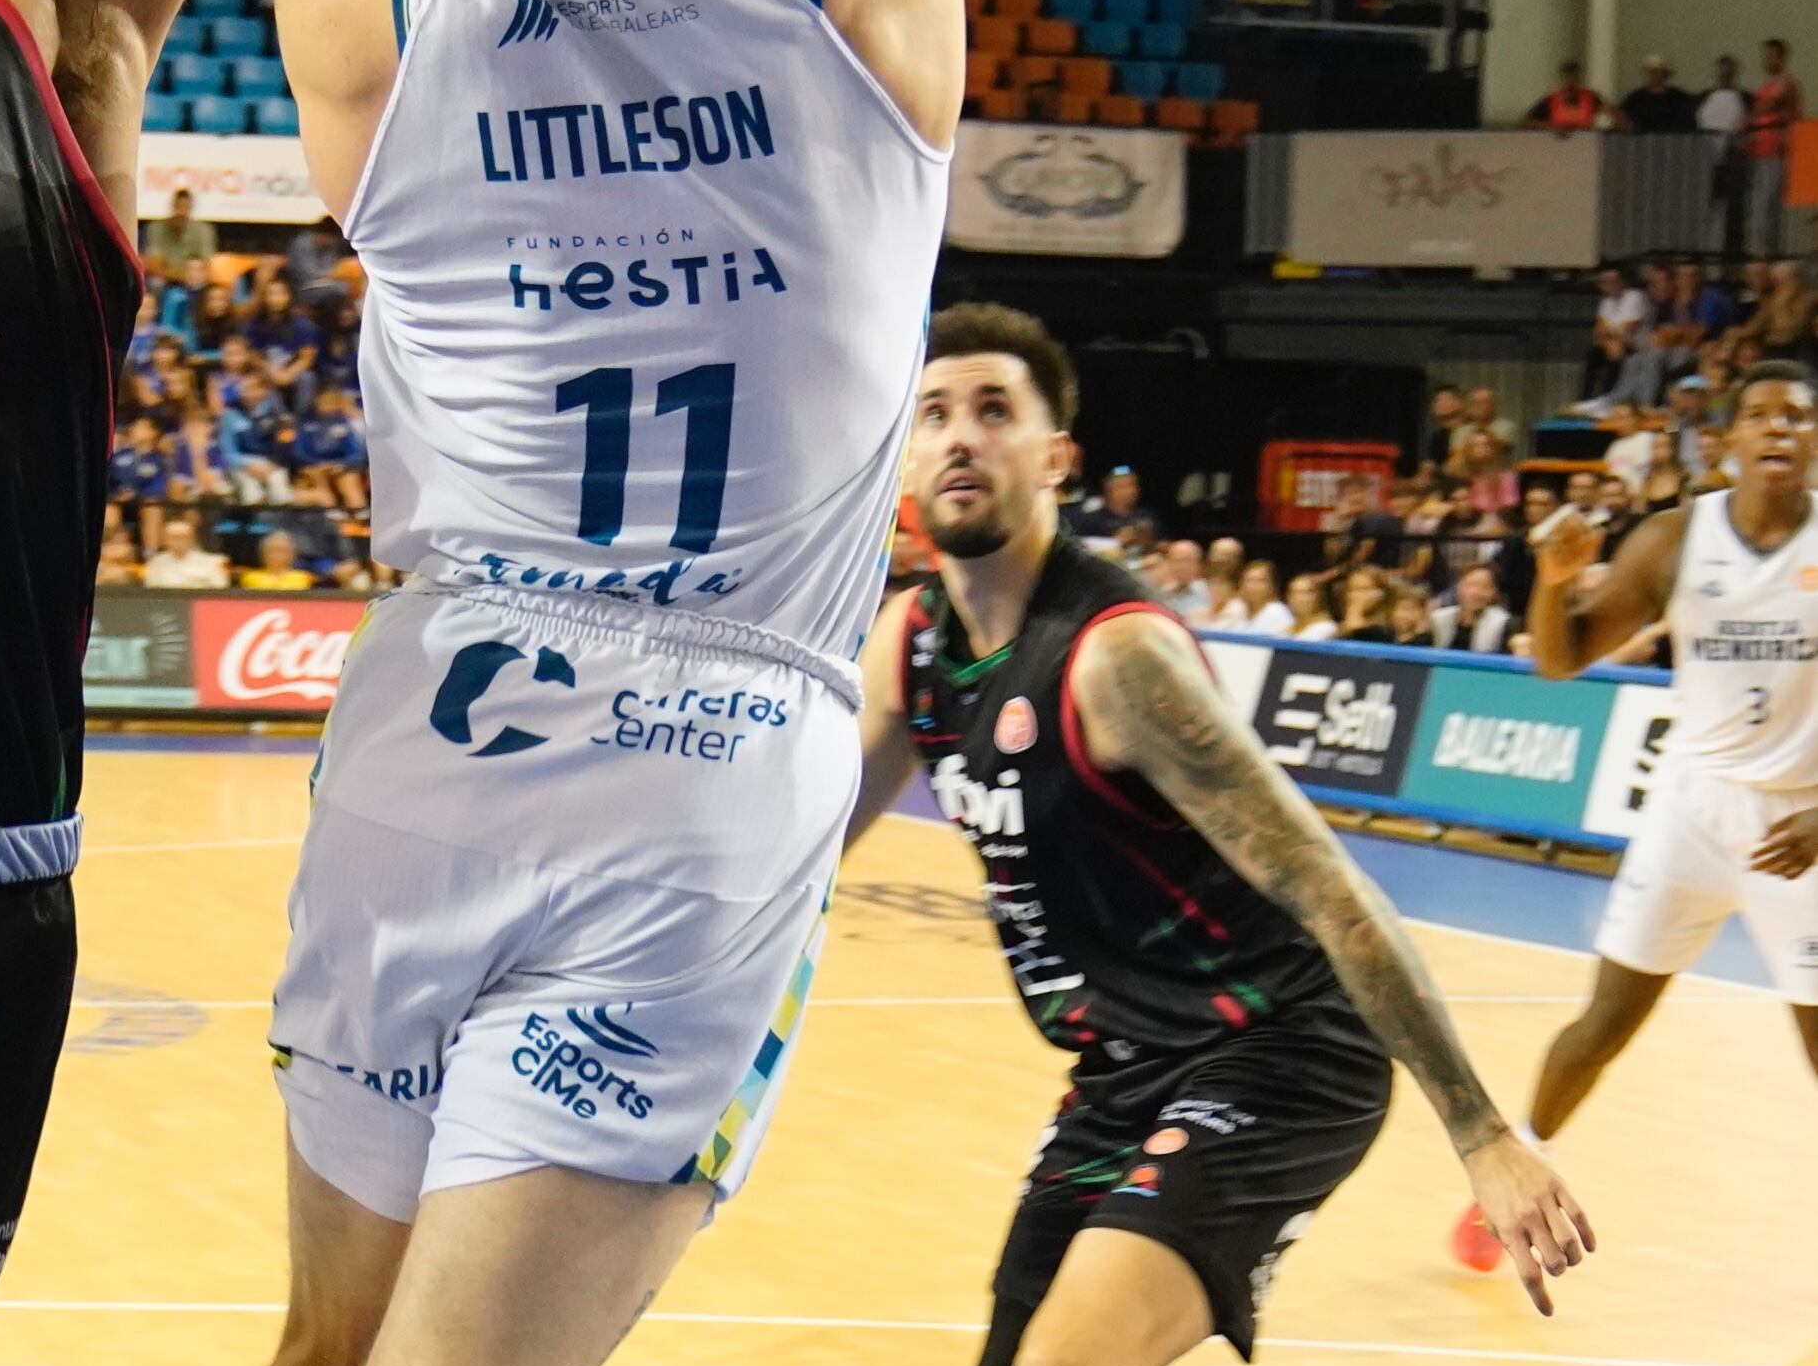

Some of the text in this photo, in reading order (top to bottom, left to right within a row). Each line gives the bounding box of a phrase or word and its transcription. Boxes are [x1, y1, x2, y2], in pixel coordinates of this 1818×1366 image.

[477, 85, 776, 183] LITTLESON
[506, 228, 695, 250] FUNDACIÓN
[554, 361, 736, 556] 11
[589, 718, 746, 764] enter
[520, 1011, 655, 1120] Esports
